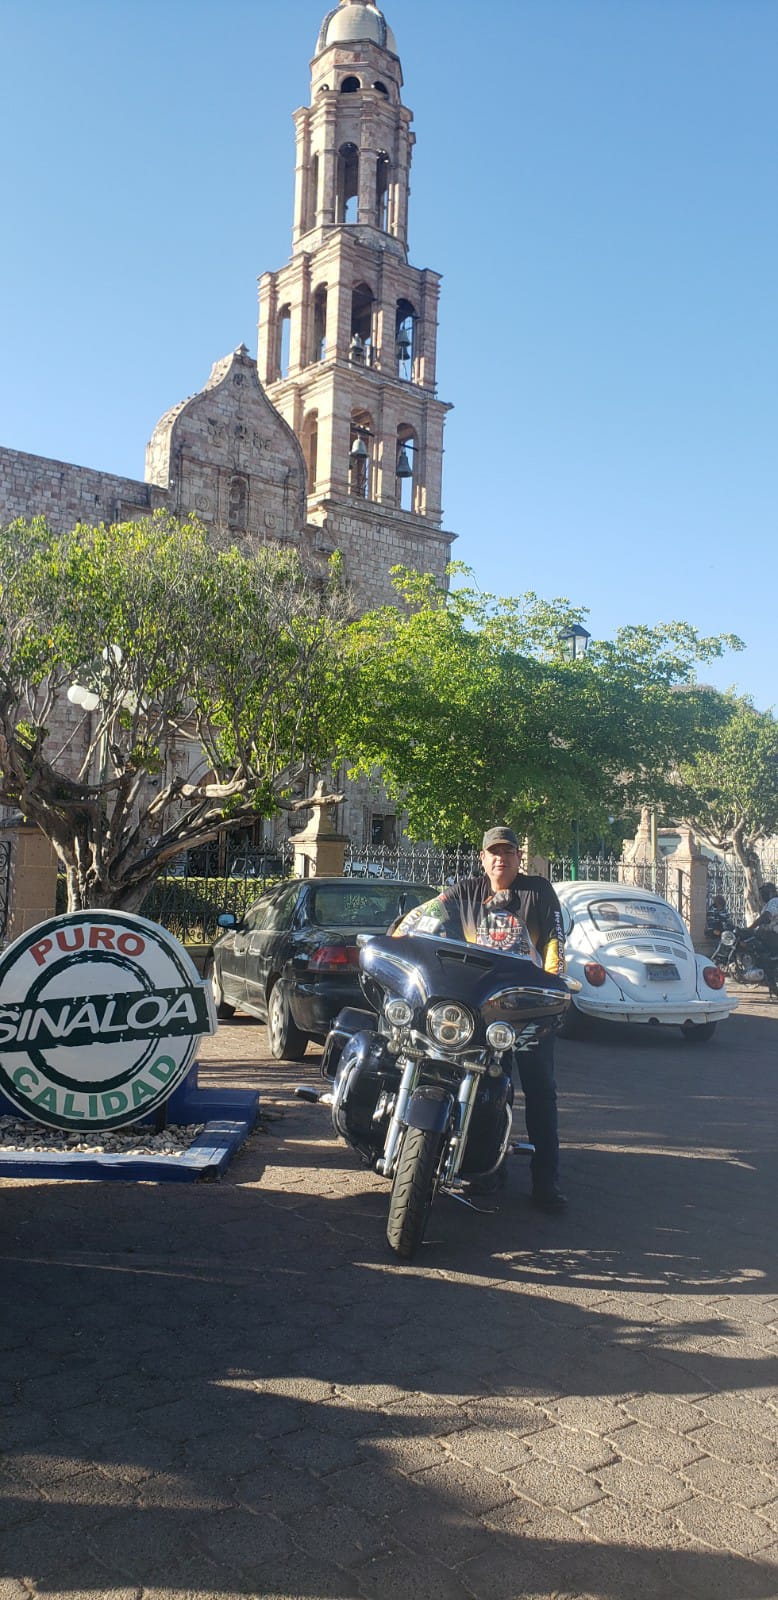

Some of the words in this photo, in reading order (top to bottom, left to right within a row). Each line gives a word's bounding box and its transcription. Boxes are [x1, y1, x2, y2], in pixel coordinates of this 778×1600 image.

[29, 926, 146, 966] PURO
[0, 993, 198, 1044] SINALOA
[12, 1055, 177, 1118] CALIDAD
